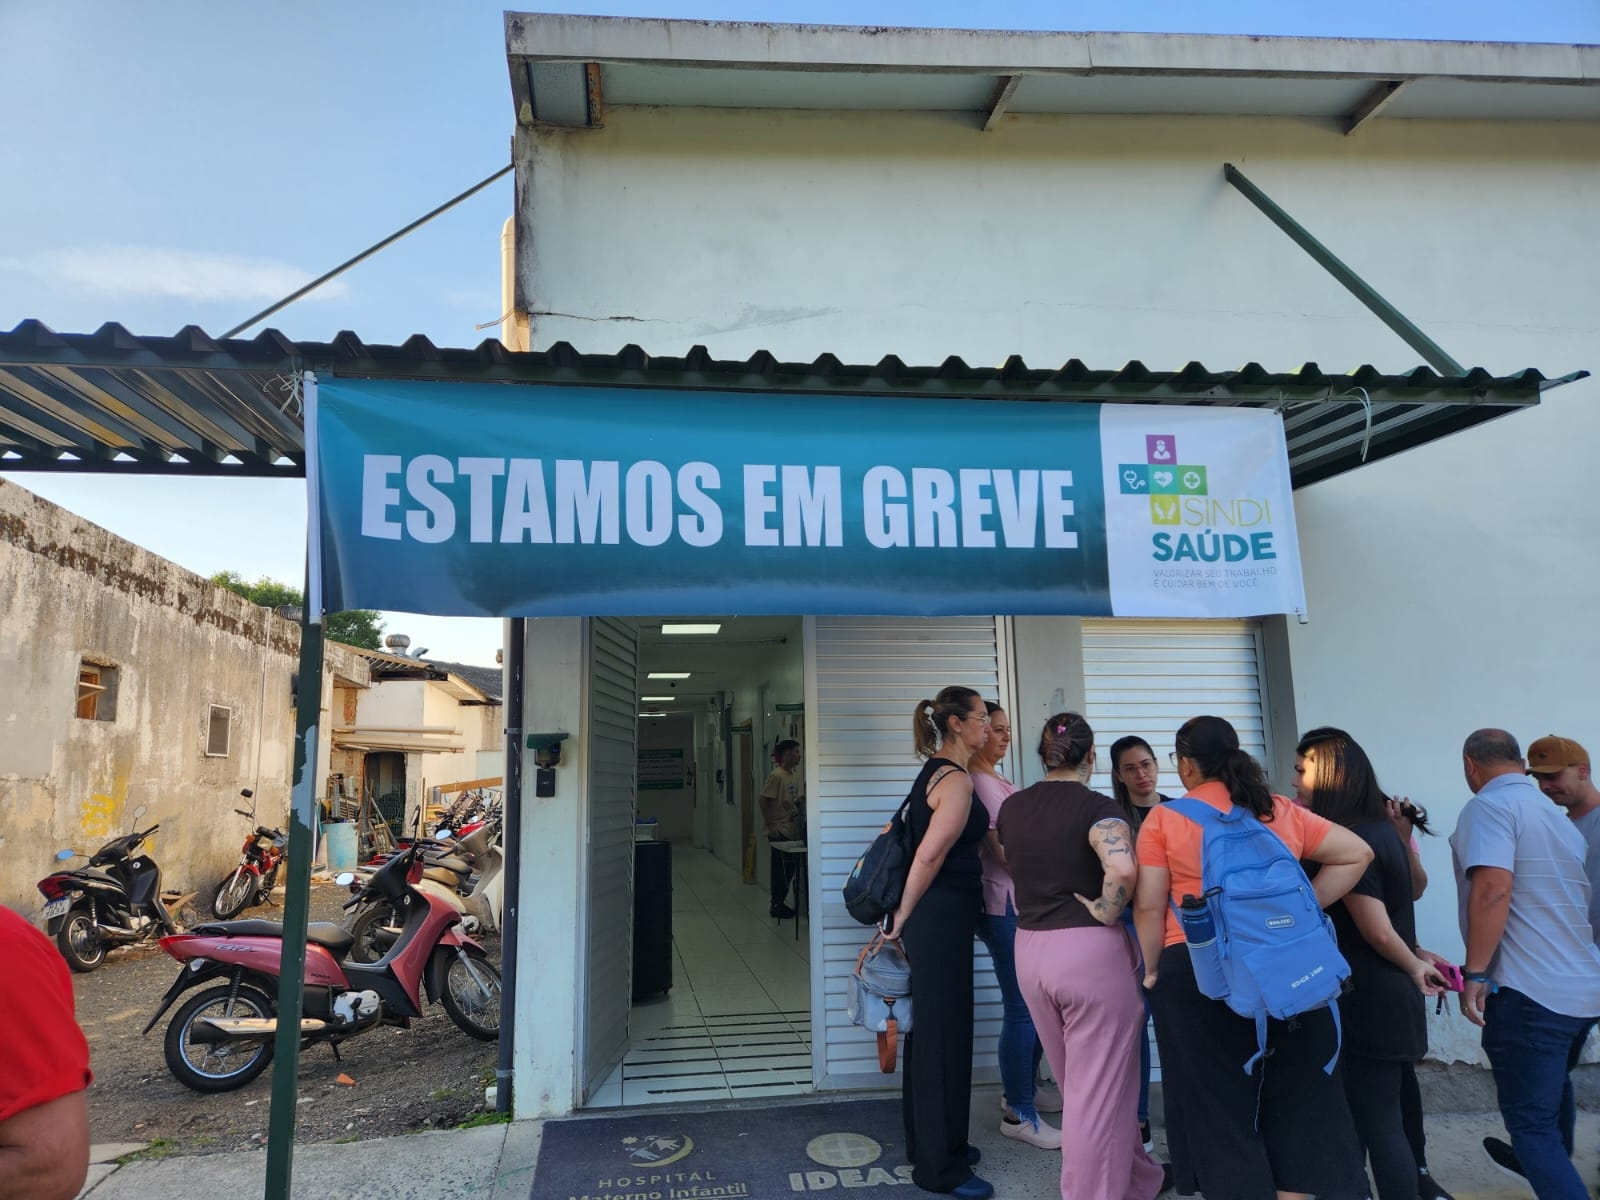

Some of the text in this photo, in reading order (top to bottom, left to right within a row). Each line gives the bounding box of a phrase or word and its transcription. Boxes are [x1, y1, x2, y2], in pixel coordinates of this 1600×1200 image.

[361, 454, 1079, 550] ESTAMOS EM GREVE
[1183, 497, 1272, 527] SINDI
[1152, 528, 1277, 562] SAÚDE
[1153, 566, 1277, 578] VALORIZAR SEU TRABALHO
[1160, 578, 1194, 588] CUIDAR
[1197, 578, 1215, 588] BEM
[1218, 578, 1230, 588] DE
[598, 1171, 717, 1188] HOSPITAL
[788, 1165, 914, 1192] IDEAS
[669, 1182, 747, 1198] Infantil
